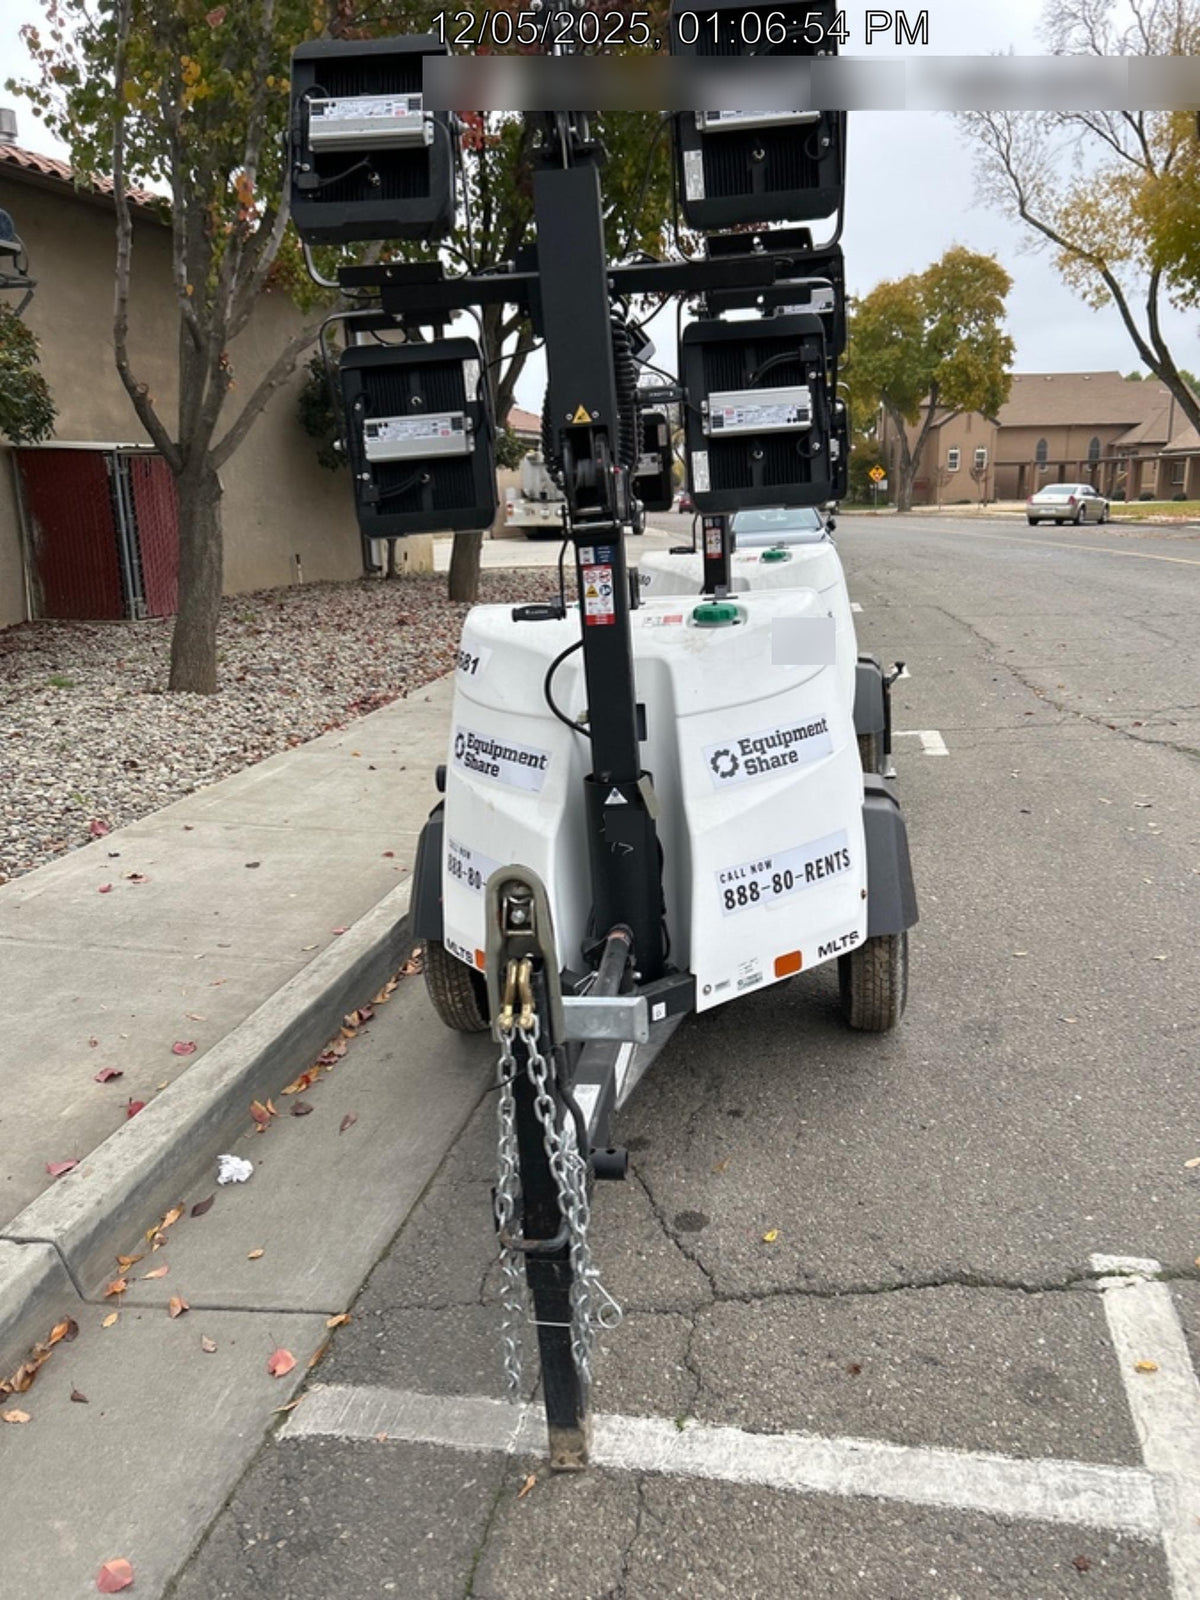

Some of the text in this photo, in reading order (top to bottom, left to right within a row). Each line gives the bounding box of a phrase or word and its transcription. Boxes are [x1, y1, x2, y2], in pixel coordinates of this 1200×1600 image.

[467, 732, 548, 770] Equipment
[737, 718, 828, 756] Equipment
[464, 752, 500, 777] Share
[744, 750, 799, 776] Share
[719, 859, 773, 884] CALL NOW
[723, 848, 850, 910] 888-80-RENTS
